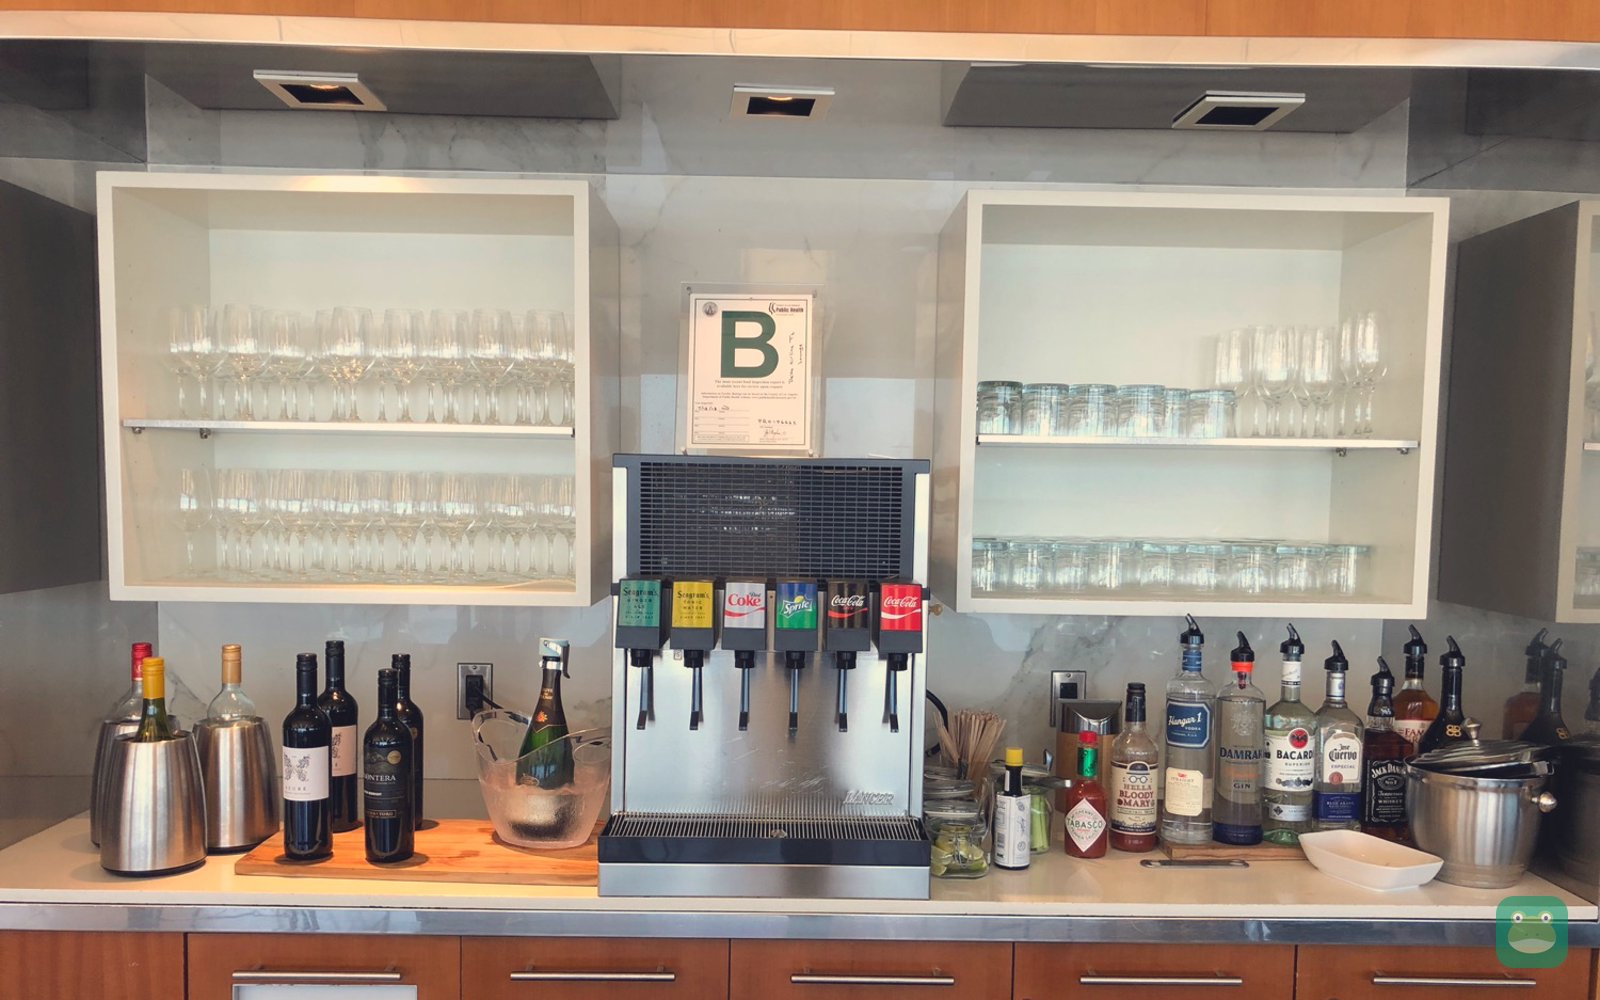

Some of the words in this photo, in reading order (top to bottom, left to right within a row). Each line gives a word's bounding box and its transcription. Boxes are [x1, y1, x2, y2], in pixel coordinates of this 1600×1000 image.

[720, 310, 779, 378] B
[623, 587, 658, 597] Seagram's
[677, 590, 710, 600] Seagram's
[728, 593, 762, 607] Coke
[783, 600, 810, 615] Sprite
[1168, 715, 1197, 728] Hangar
[1196, 711, 1202, 723] 1
[1276, 749, 1314, 760] BACARD
[1328, 748, 1358, 762] Cuervo
[1371, 766, 1388, 779] JACK
[1123, 783, 1152, 791] HELLA
[1119, 789, 1154, 799] BLOODY
[1123, 798, 1150, 808] MARY
[1067, 817, 1104, 829] TABASCO
